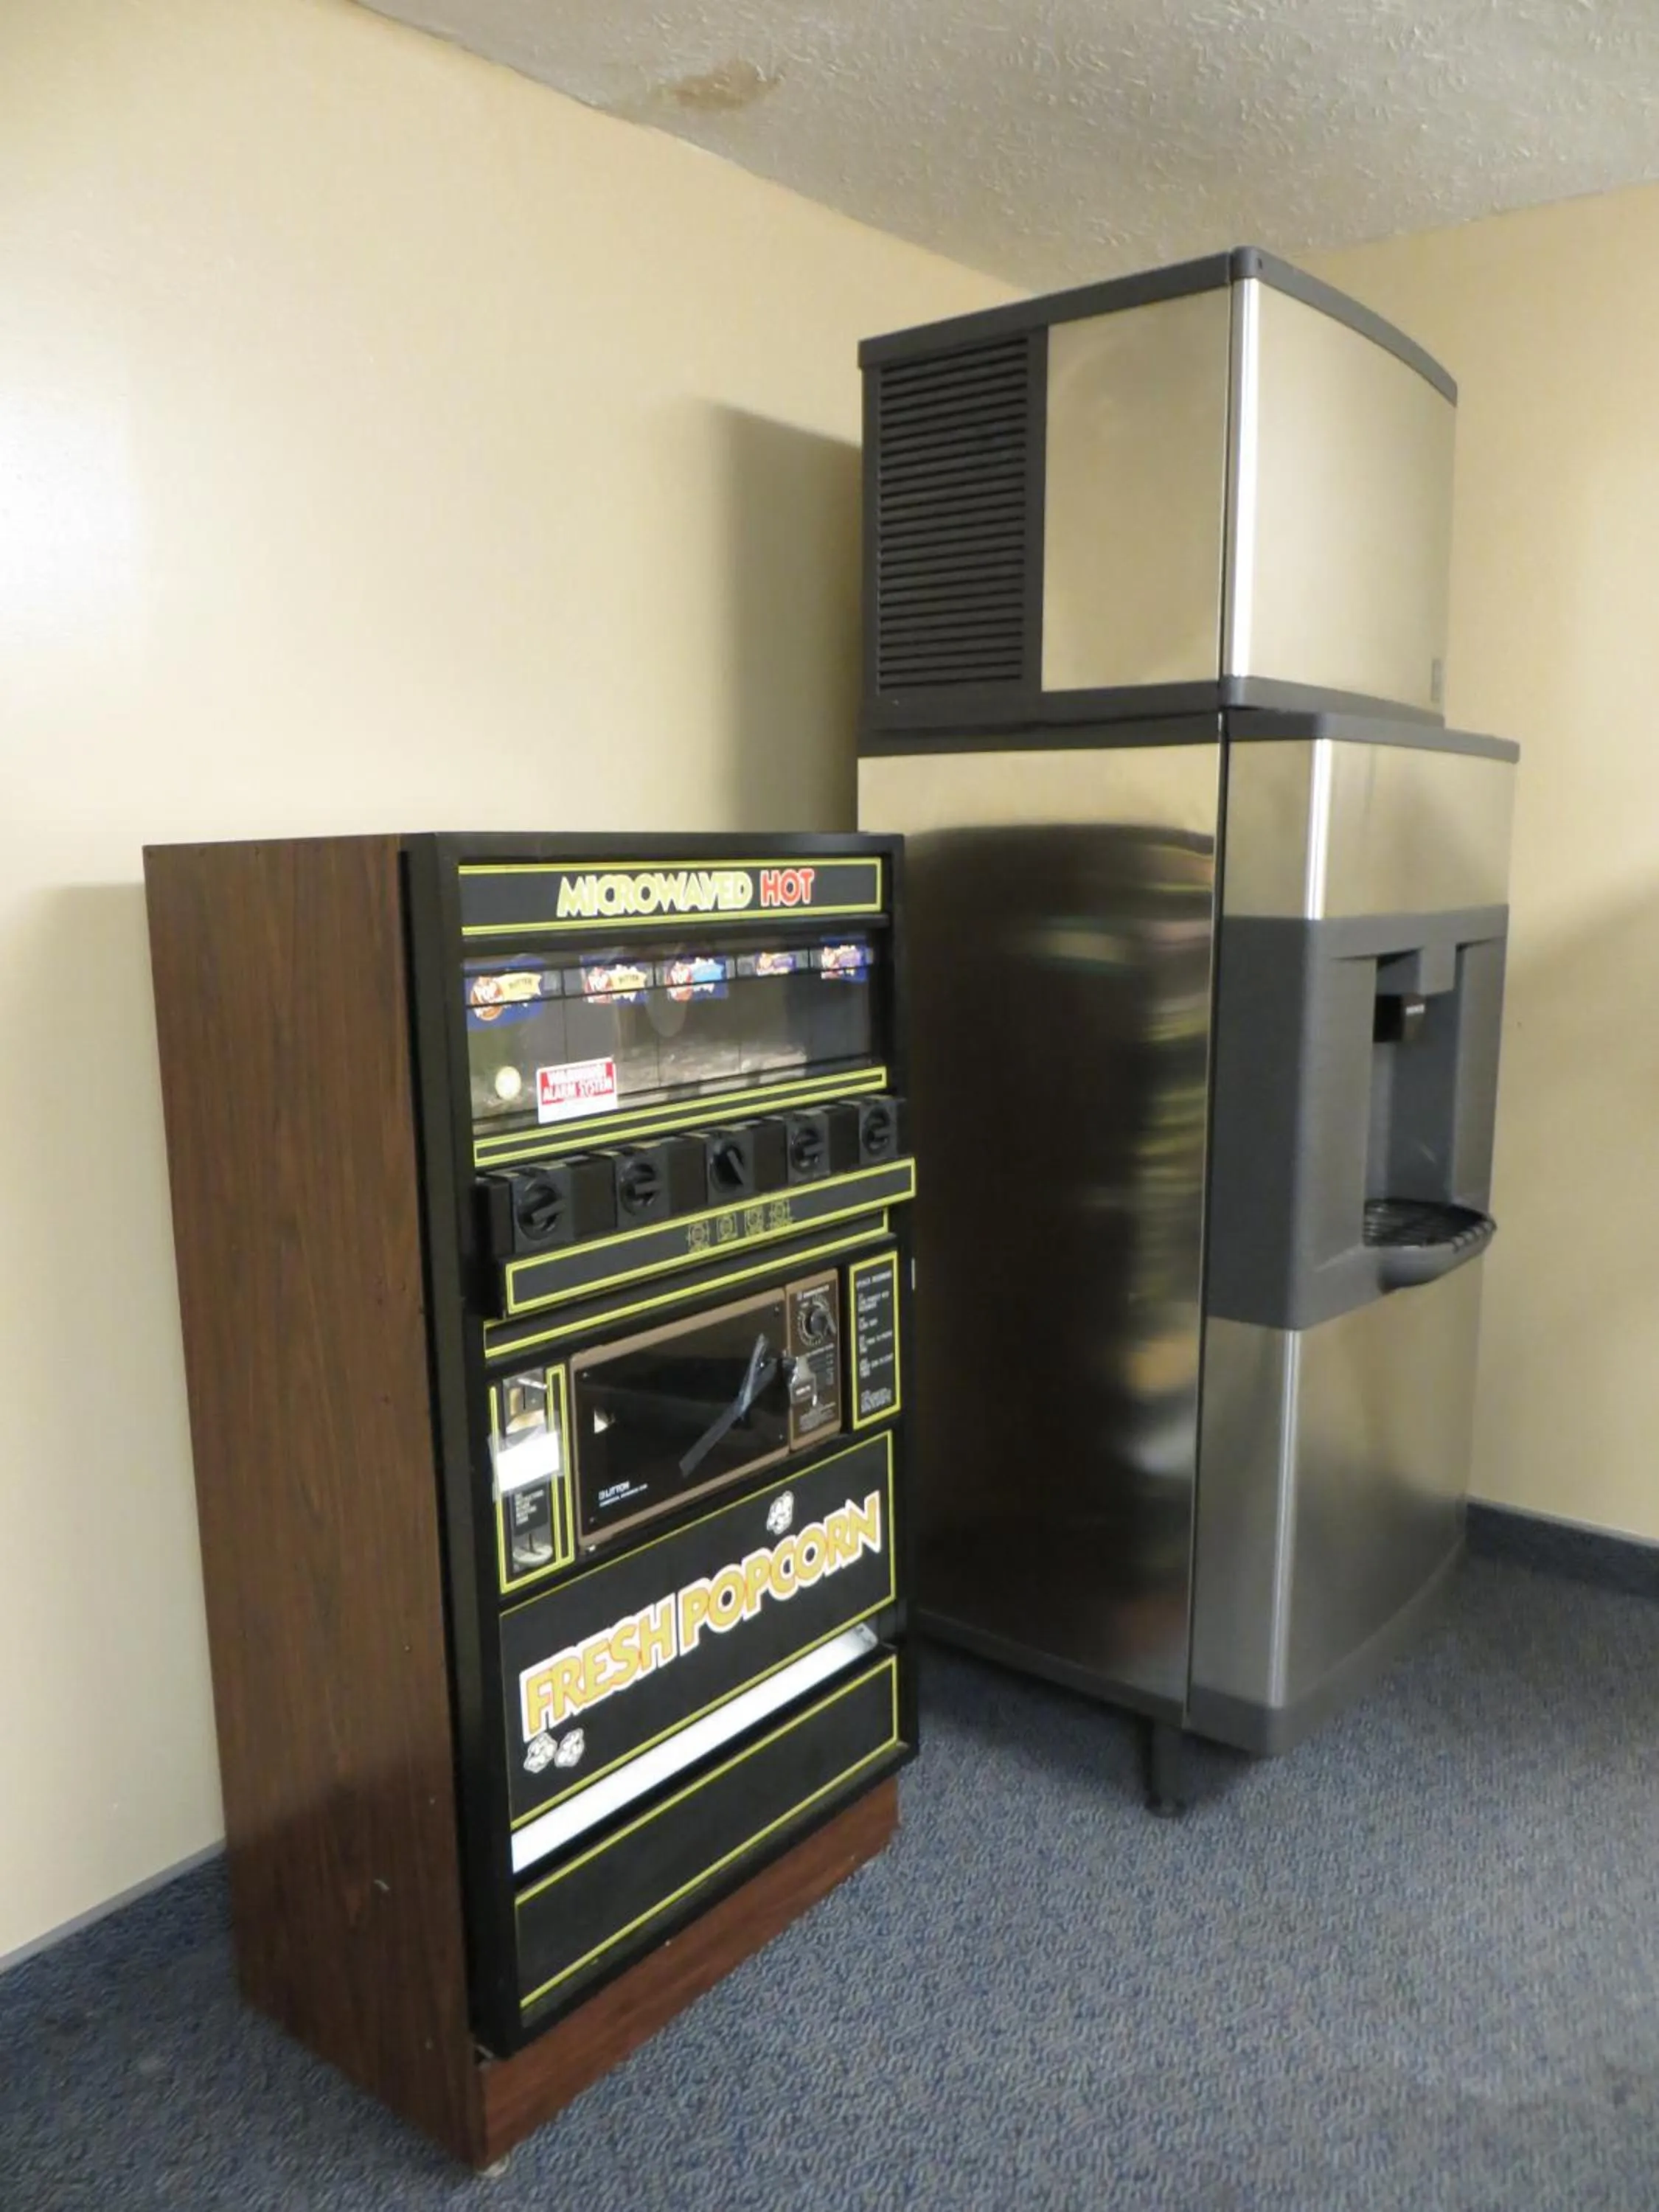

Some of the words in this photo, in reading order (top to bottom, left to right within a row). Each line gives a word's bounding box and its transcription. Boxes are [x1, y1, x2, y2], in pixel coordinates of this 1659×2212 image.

[557, 872, 754, 917] MICROWAVED
[760, 869, 815, 908] HOT
[543, 1082, 575, 1101] ALARM
[519, 1592, 675, 1744] FRESH
[675, 1489, 881, 1657] POPCORN
